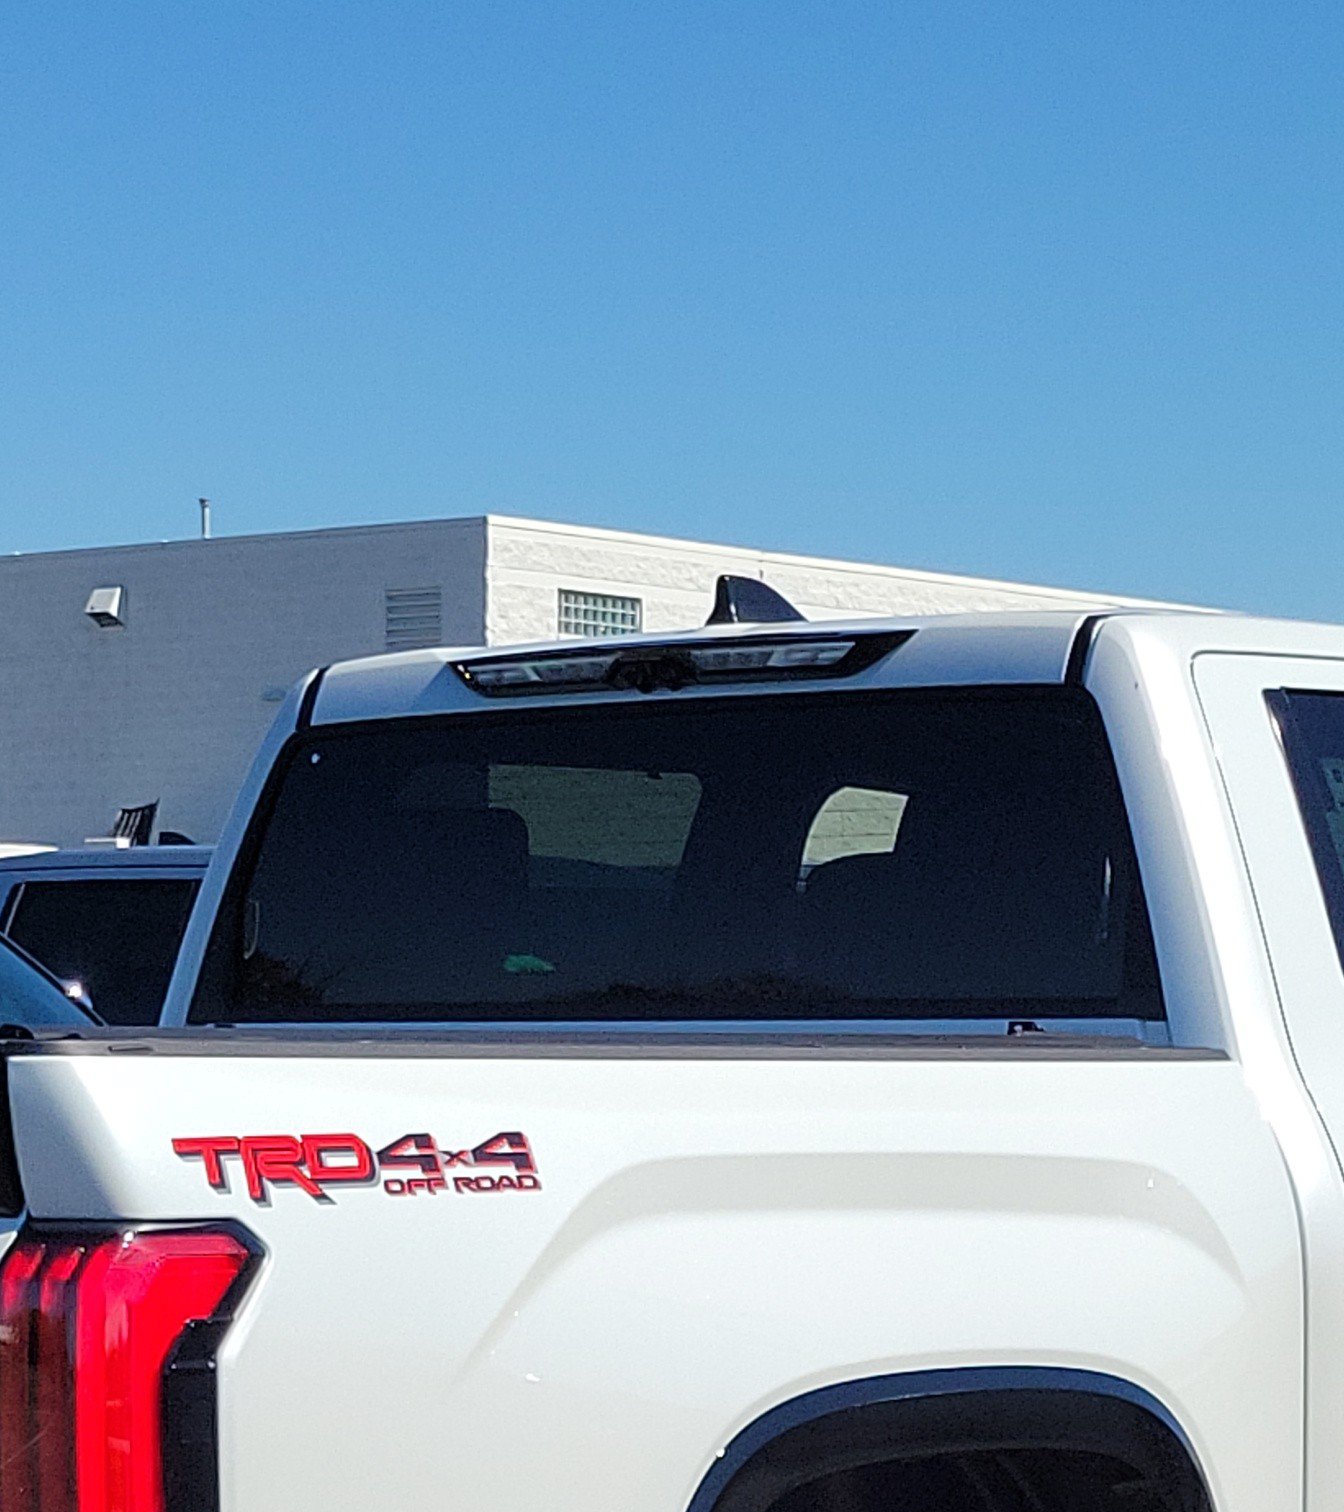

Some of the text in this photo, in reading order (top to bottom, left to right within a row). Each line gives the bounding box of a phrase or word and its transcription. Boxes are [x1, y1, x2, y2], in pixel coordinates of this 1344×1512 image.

[172, 1131, 539, 1207] TRD 4x4
[384, 1175, 541, 1196] OFF ROAD
